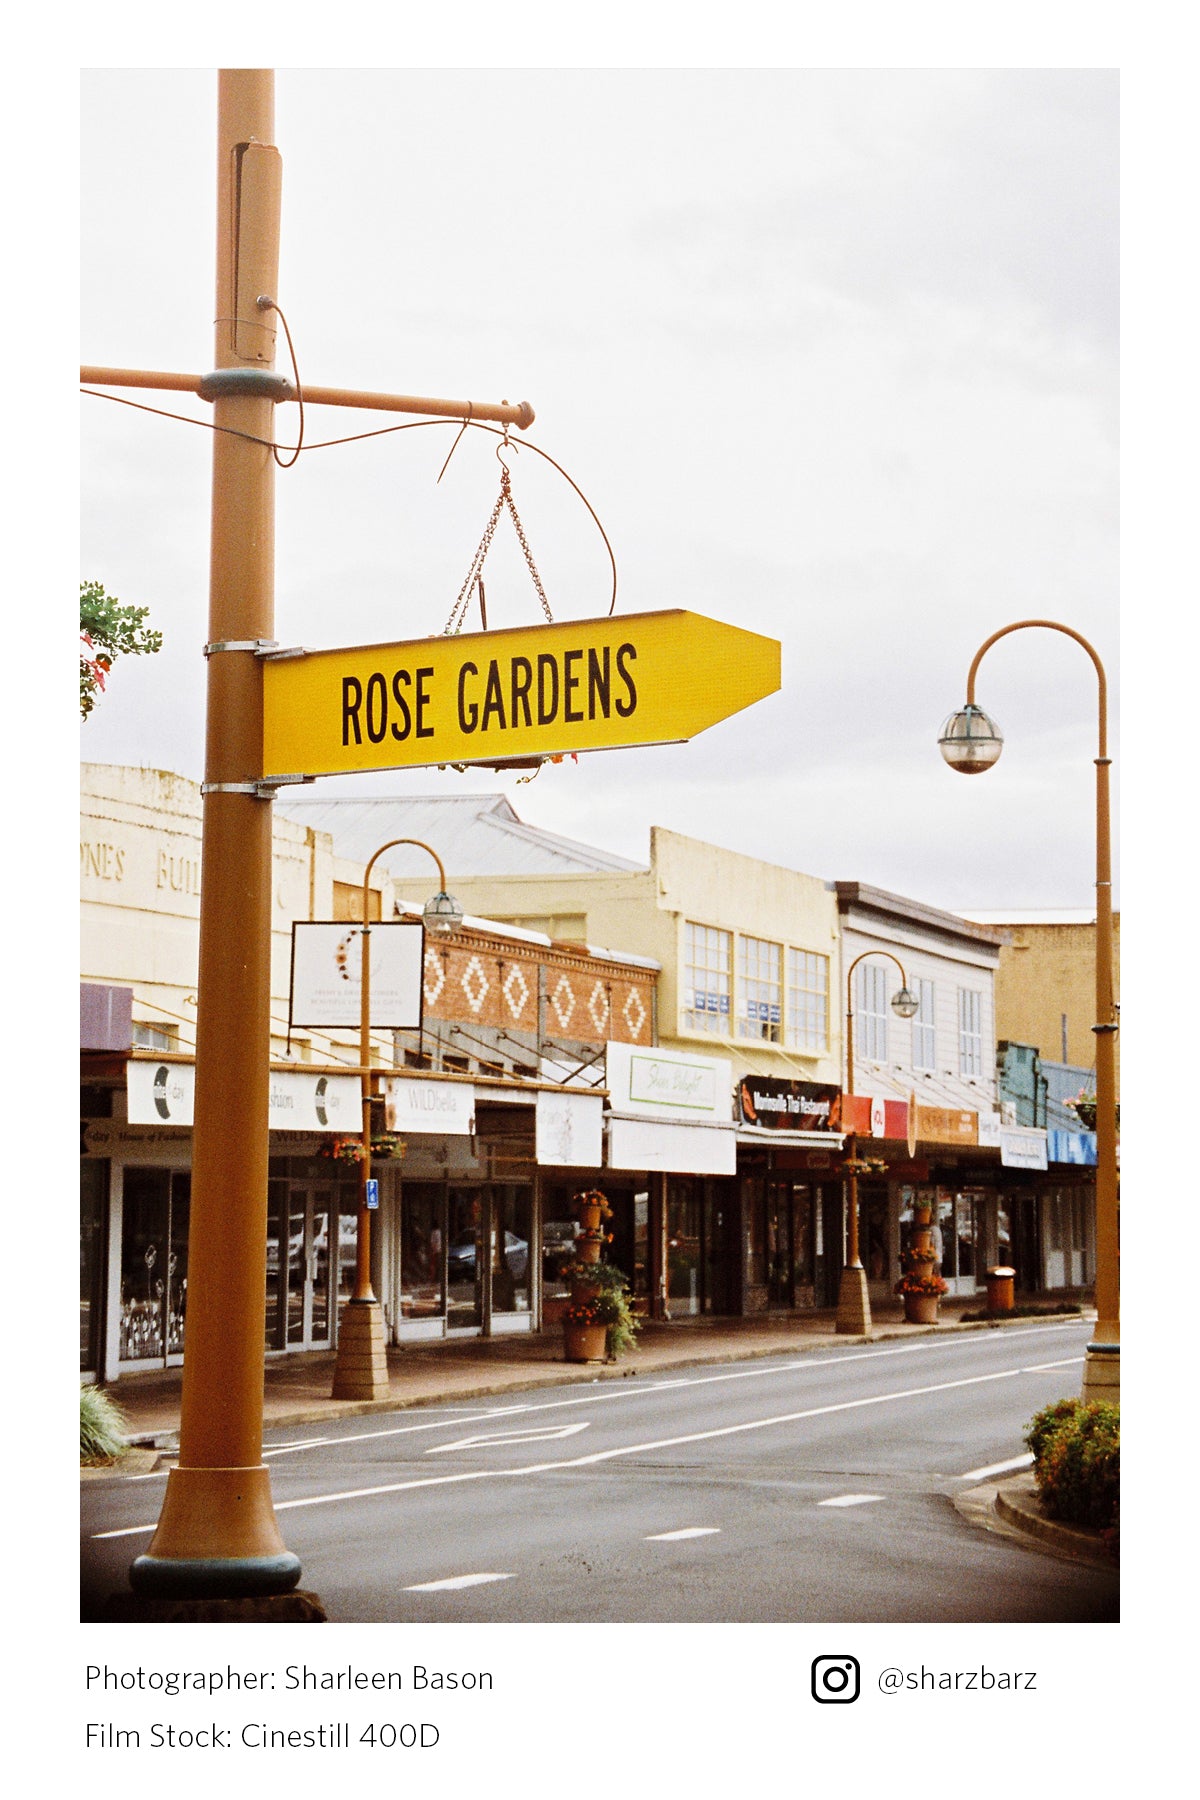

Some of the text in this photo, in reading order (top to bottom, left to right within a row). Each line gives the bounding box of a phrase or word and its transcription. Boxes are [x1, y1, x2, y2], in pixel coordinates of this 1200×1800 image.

[342, 643, 638, 746] ROSE GARDENS
[270, 1086, 294, 1109] shion
